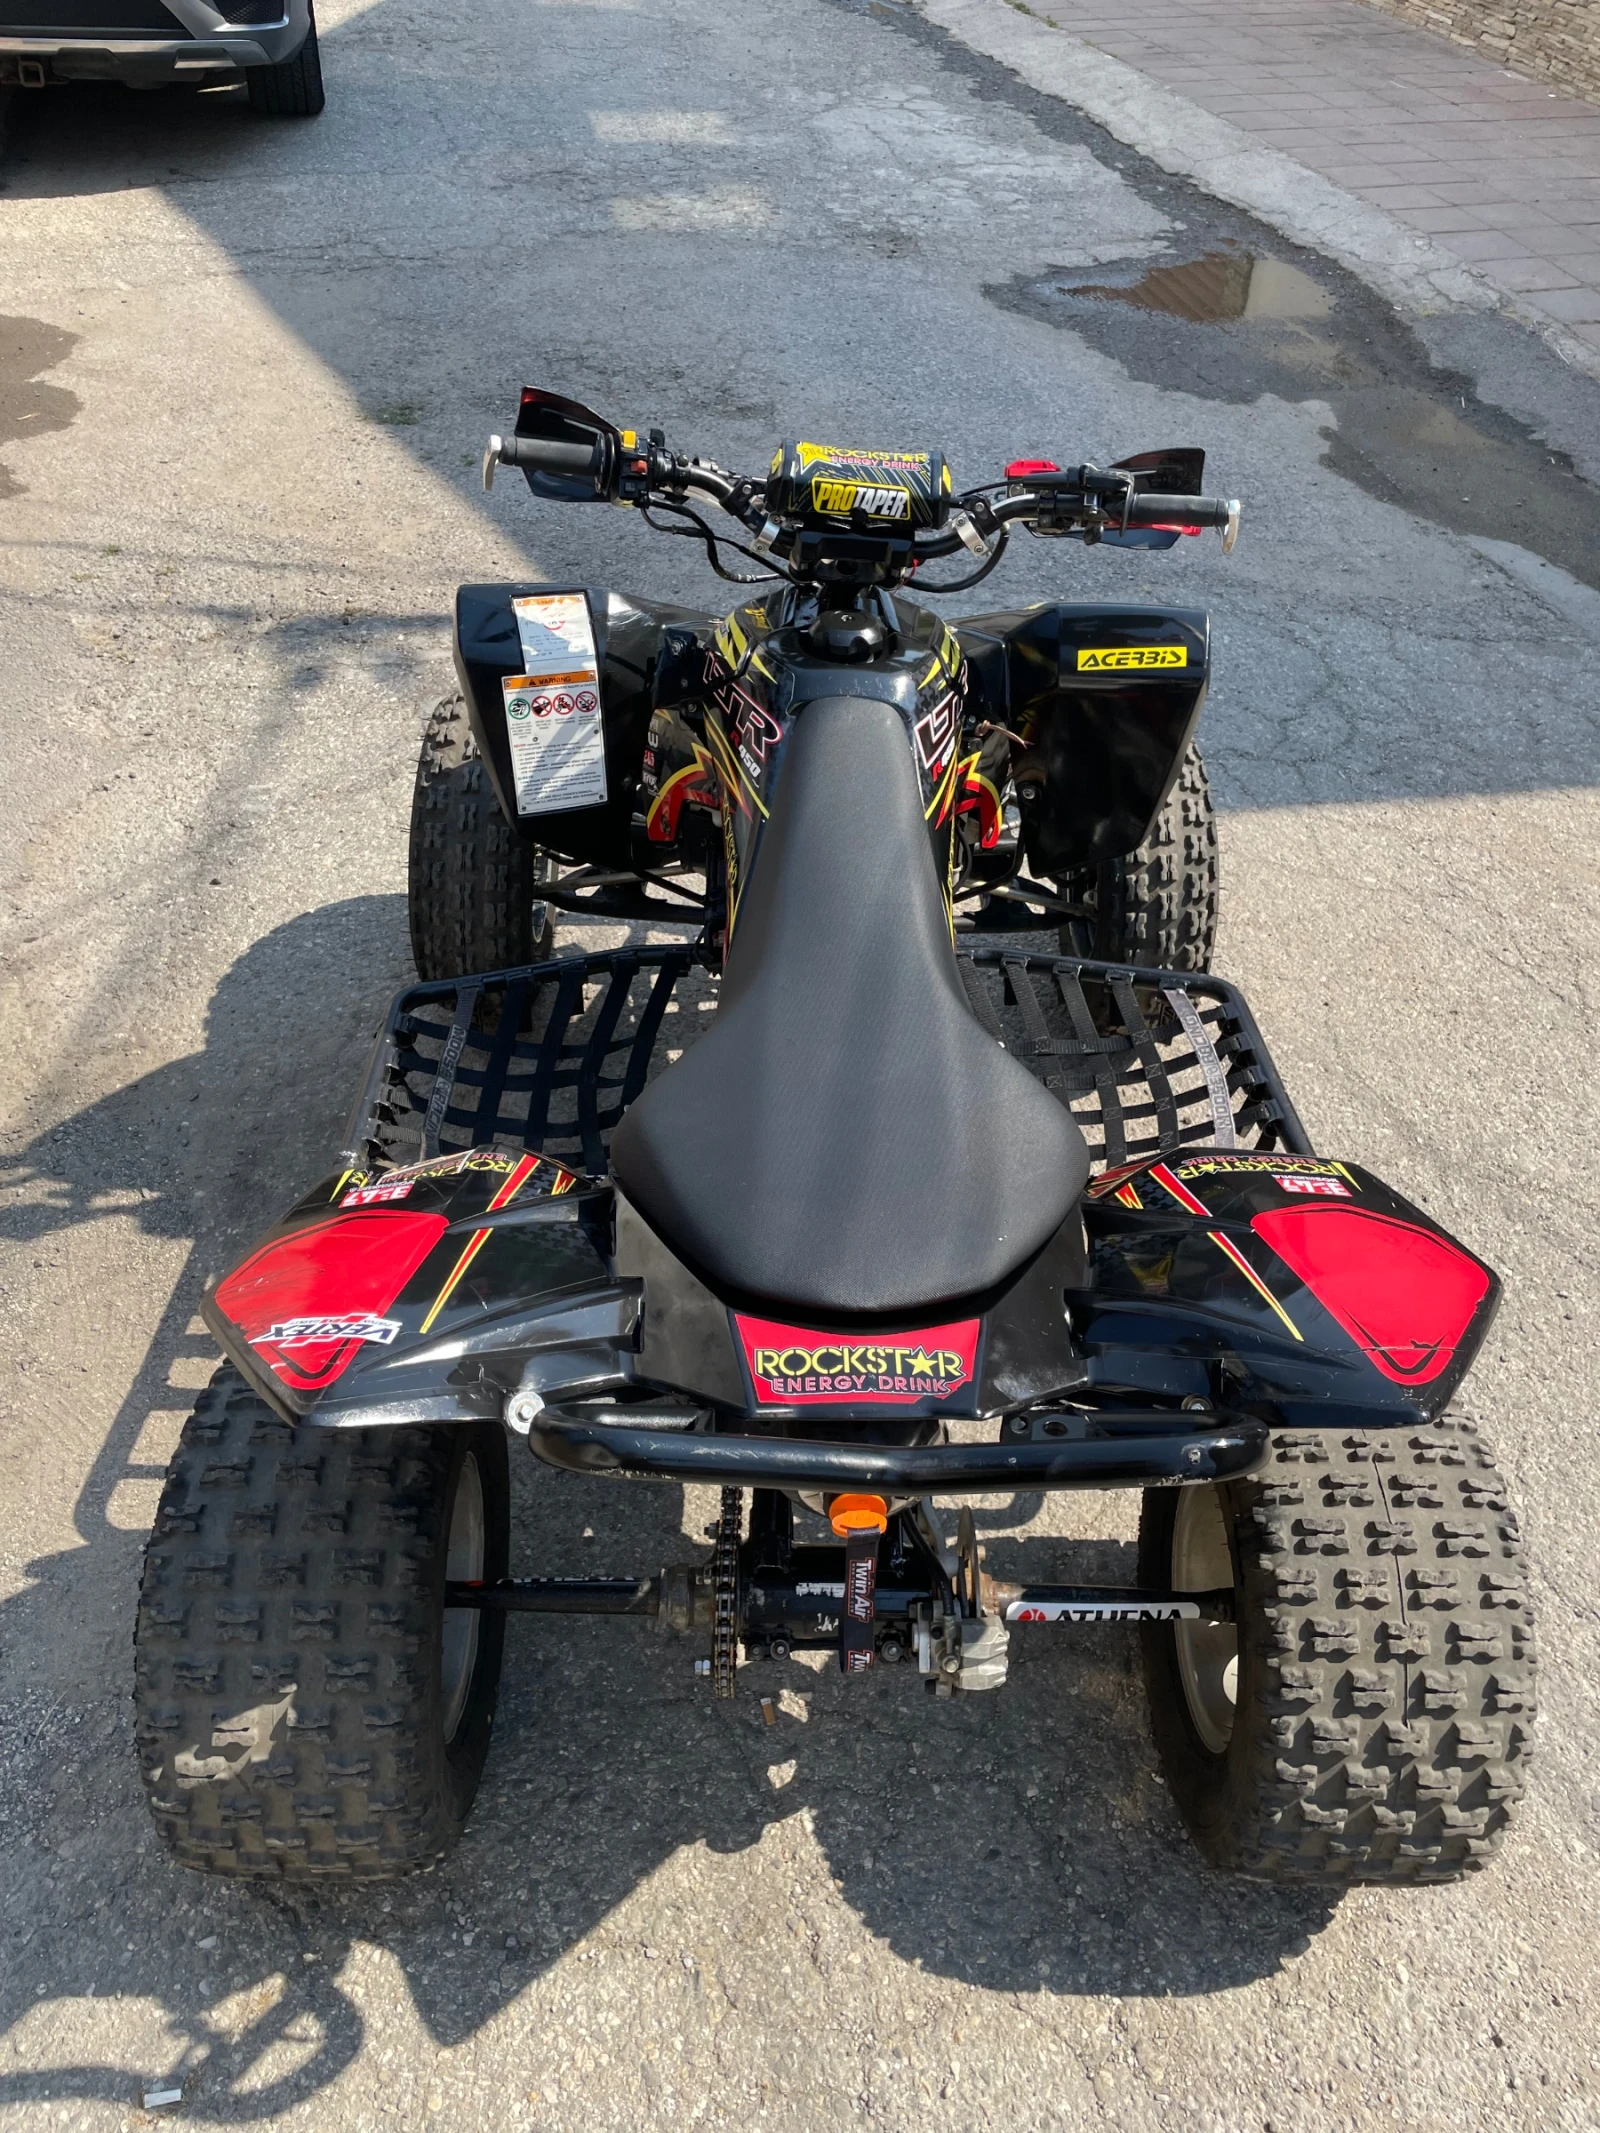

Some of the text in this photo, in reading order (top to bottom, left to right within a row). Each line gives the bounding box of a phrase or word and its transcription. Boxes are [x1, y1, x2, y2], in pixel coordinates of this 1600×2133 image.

[831, 456, 920, 470] ENERGY DRINK
[1081, 650, 1182, 668] ACERBIS
[538, 675, 572, 685] WARNING
[424, 1087, 450, 1140] RACIN
[1185, 1155, 1317, 1166] ENERGY DRINK
[259, 1323, 393, 1341] VERTEX
[773, 1375, 946, 1392] ENERGY DRINK
[854, 1559, 873, 1619] Twin Air
